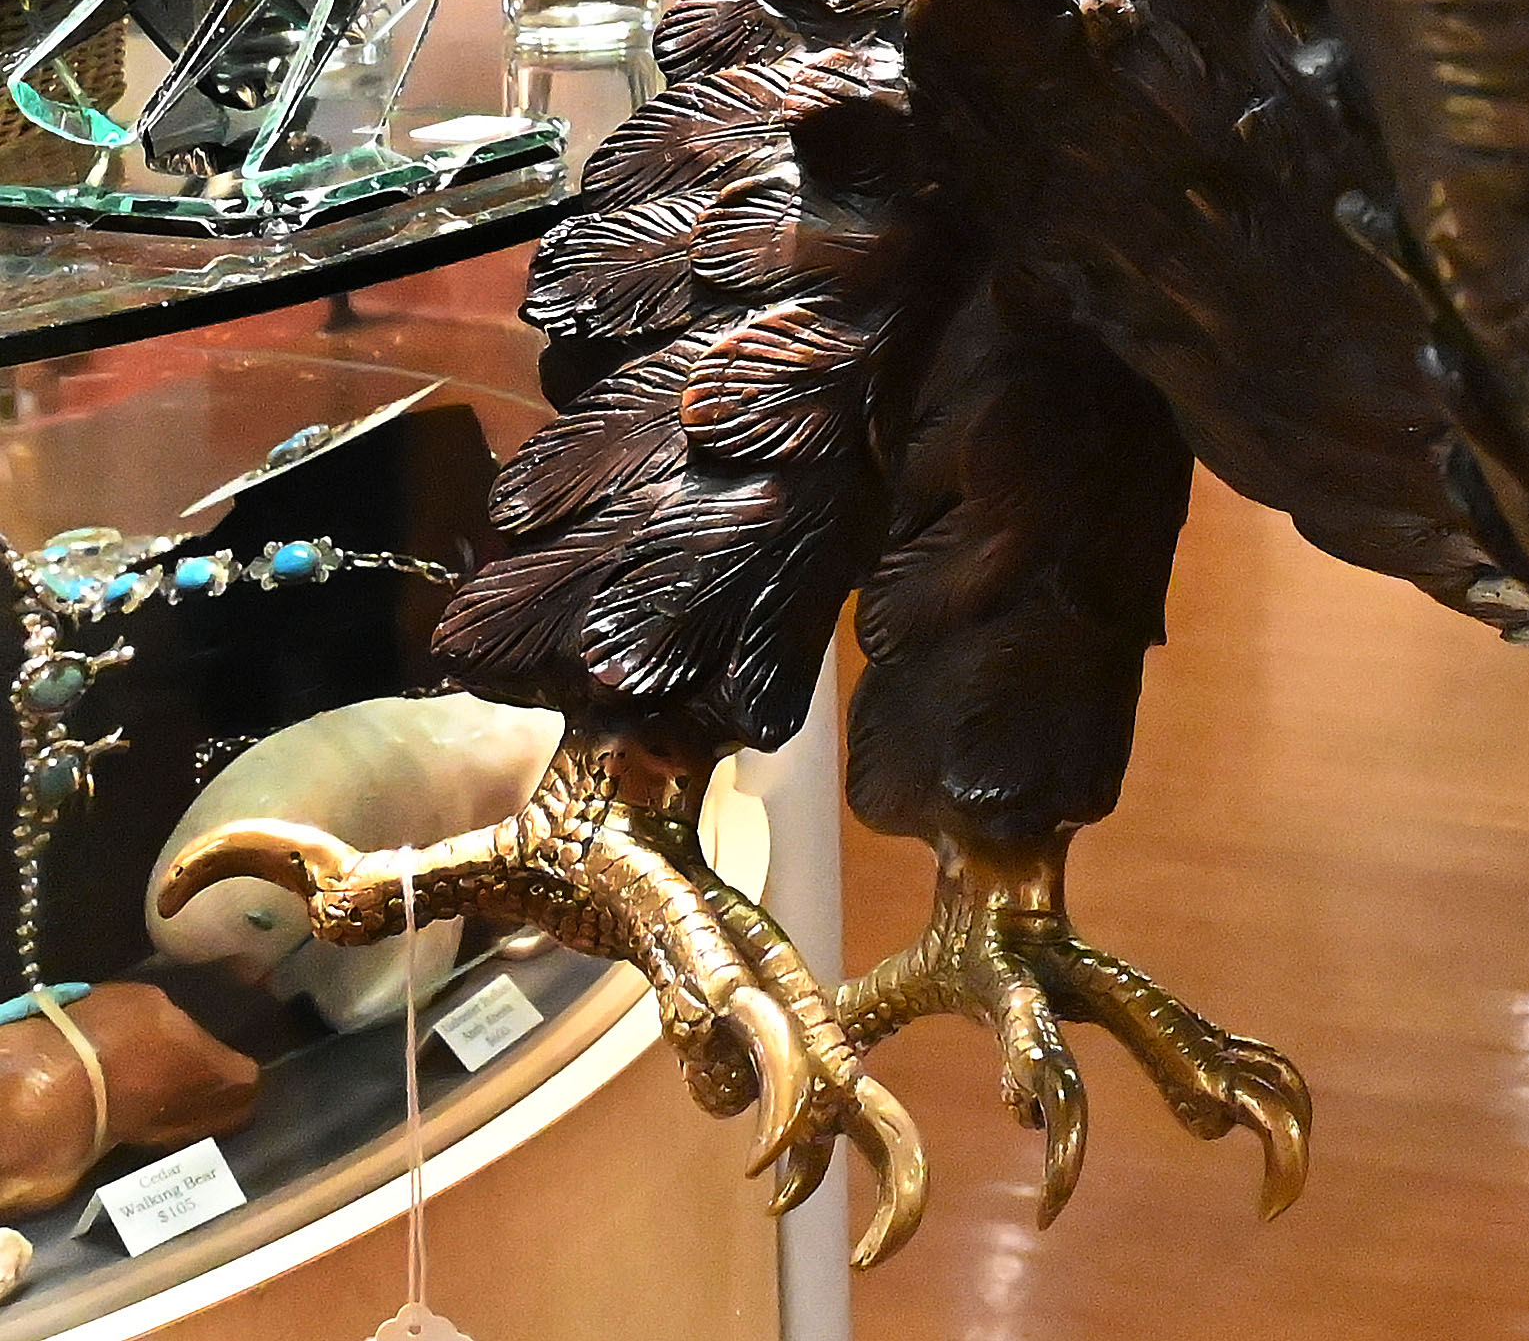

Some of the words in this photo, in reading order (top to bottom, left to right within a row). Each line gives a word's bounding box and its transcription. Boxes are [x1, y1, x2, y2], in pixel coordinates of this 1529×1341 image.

[139, 1164, 182, 1188] Cedar
[119, 1185, 183, 1218] Walking
[183, 1168, 217, 1190] Bear
[157, 1197, 197, 1223] $105
